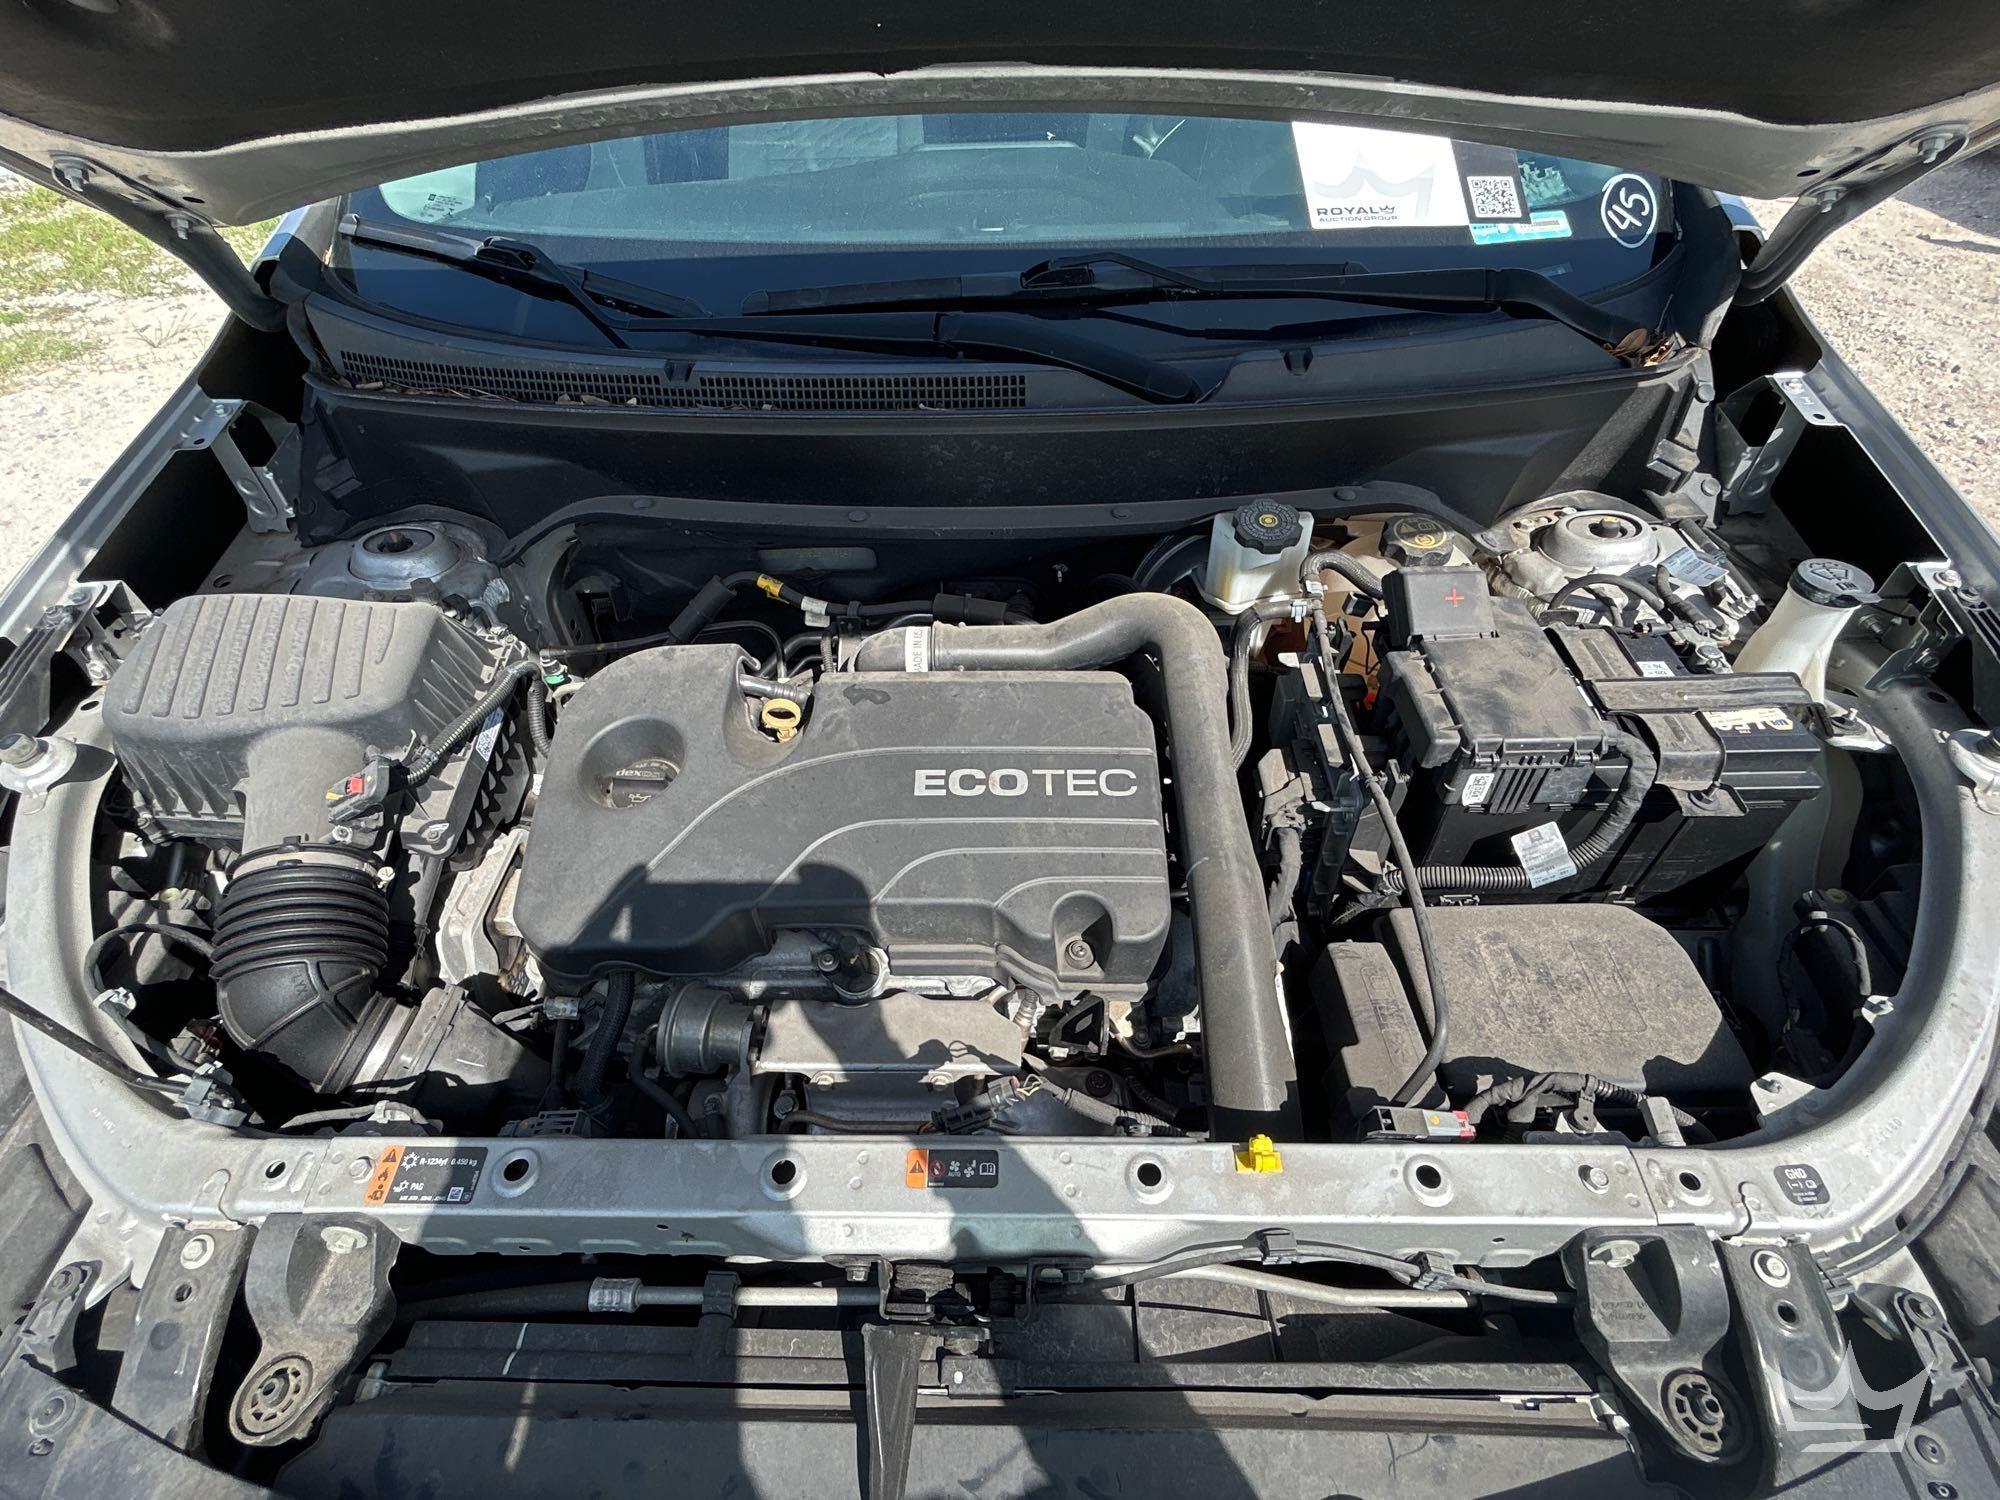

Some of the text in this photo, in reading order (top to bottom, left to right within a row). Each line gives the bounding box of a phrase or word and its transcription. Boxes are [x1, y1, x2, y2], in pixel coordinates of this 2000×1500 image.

[1316, 206, 1380, 216] ROYAL
[1607, 187, 1650, 230] 45
[913, 768, 1138, 797] ECOTEC
[450, 1158, 468, 1166] 0.450
[468, 1158, 478, 1167] kg
[1784, 1167, 1807, 1180] GND
[410, 1182, 425, 1191] PAG
